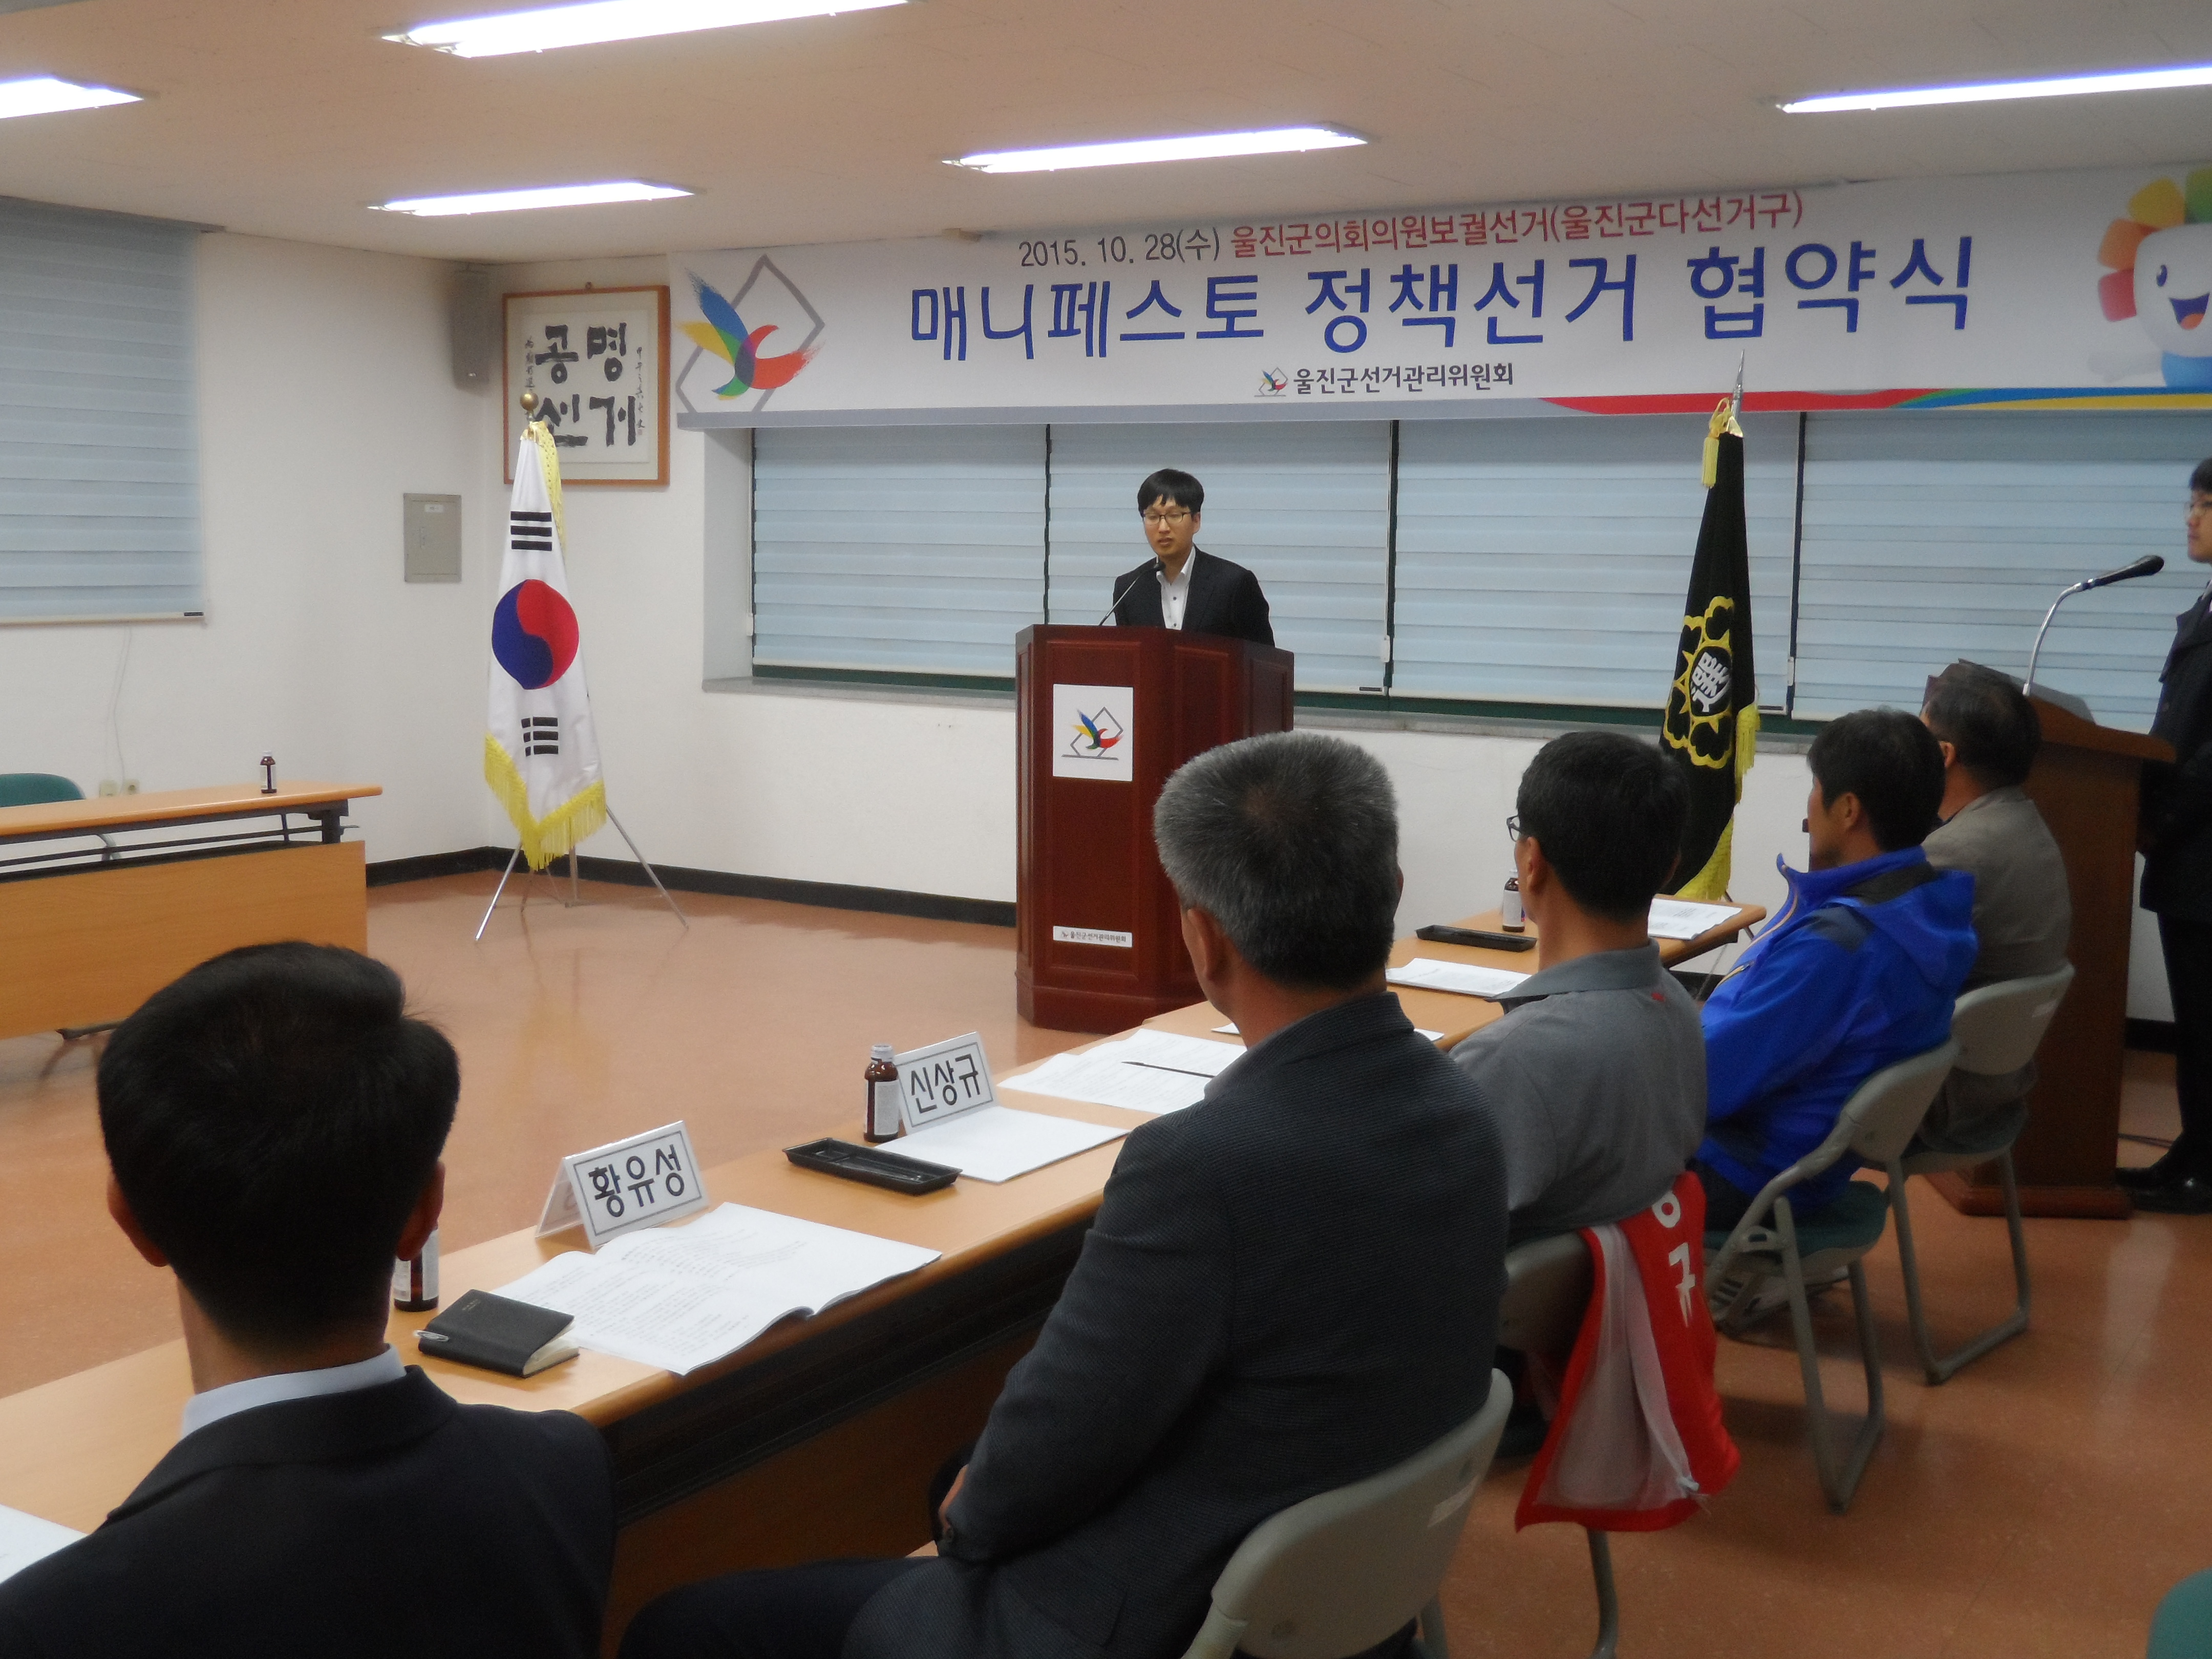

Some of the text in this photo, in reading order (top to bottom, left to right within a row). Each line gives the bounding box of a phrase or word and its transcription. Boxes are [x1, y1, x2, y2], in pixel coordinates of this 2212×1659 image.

[1018, 190, 1803, 267] 2015. 10. 28(수) 울진군의회의원보궐선거(울진군다선거구)
[912, 237, 1972, 361] 매니페스토 정책선거 협약식
[535, 322, 627, 384] 공명
[1293, 363, 1514, 395] 울진군선거관리위원회
[910, 1053, 981, 1114] 신상규
[588, 1143, 685, 1218] 황유성
